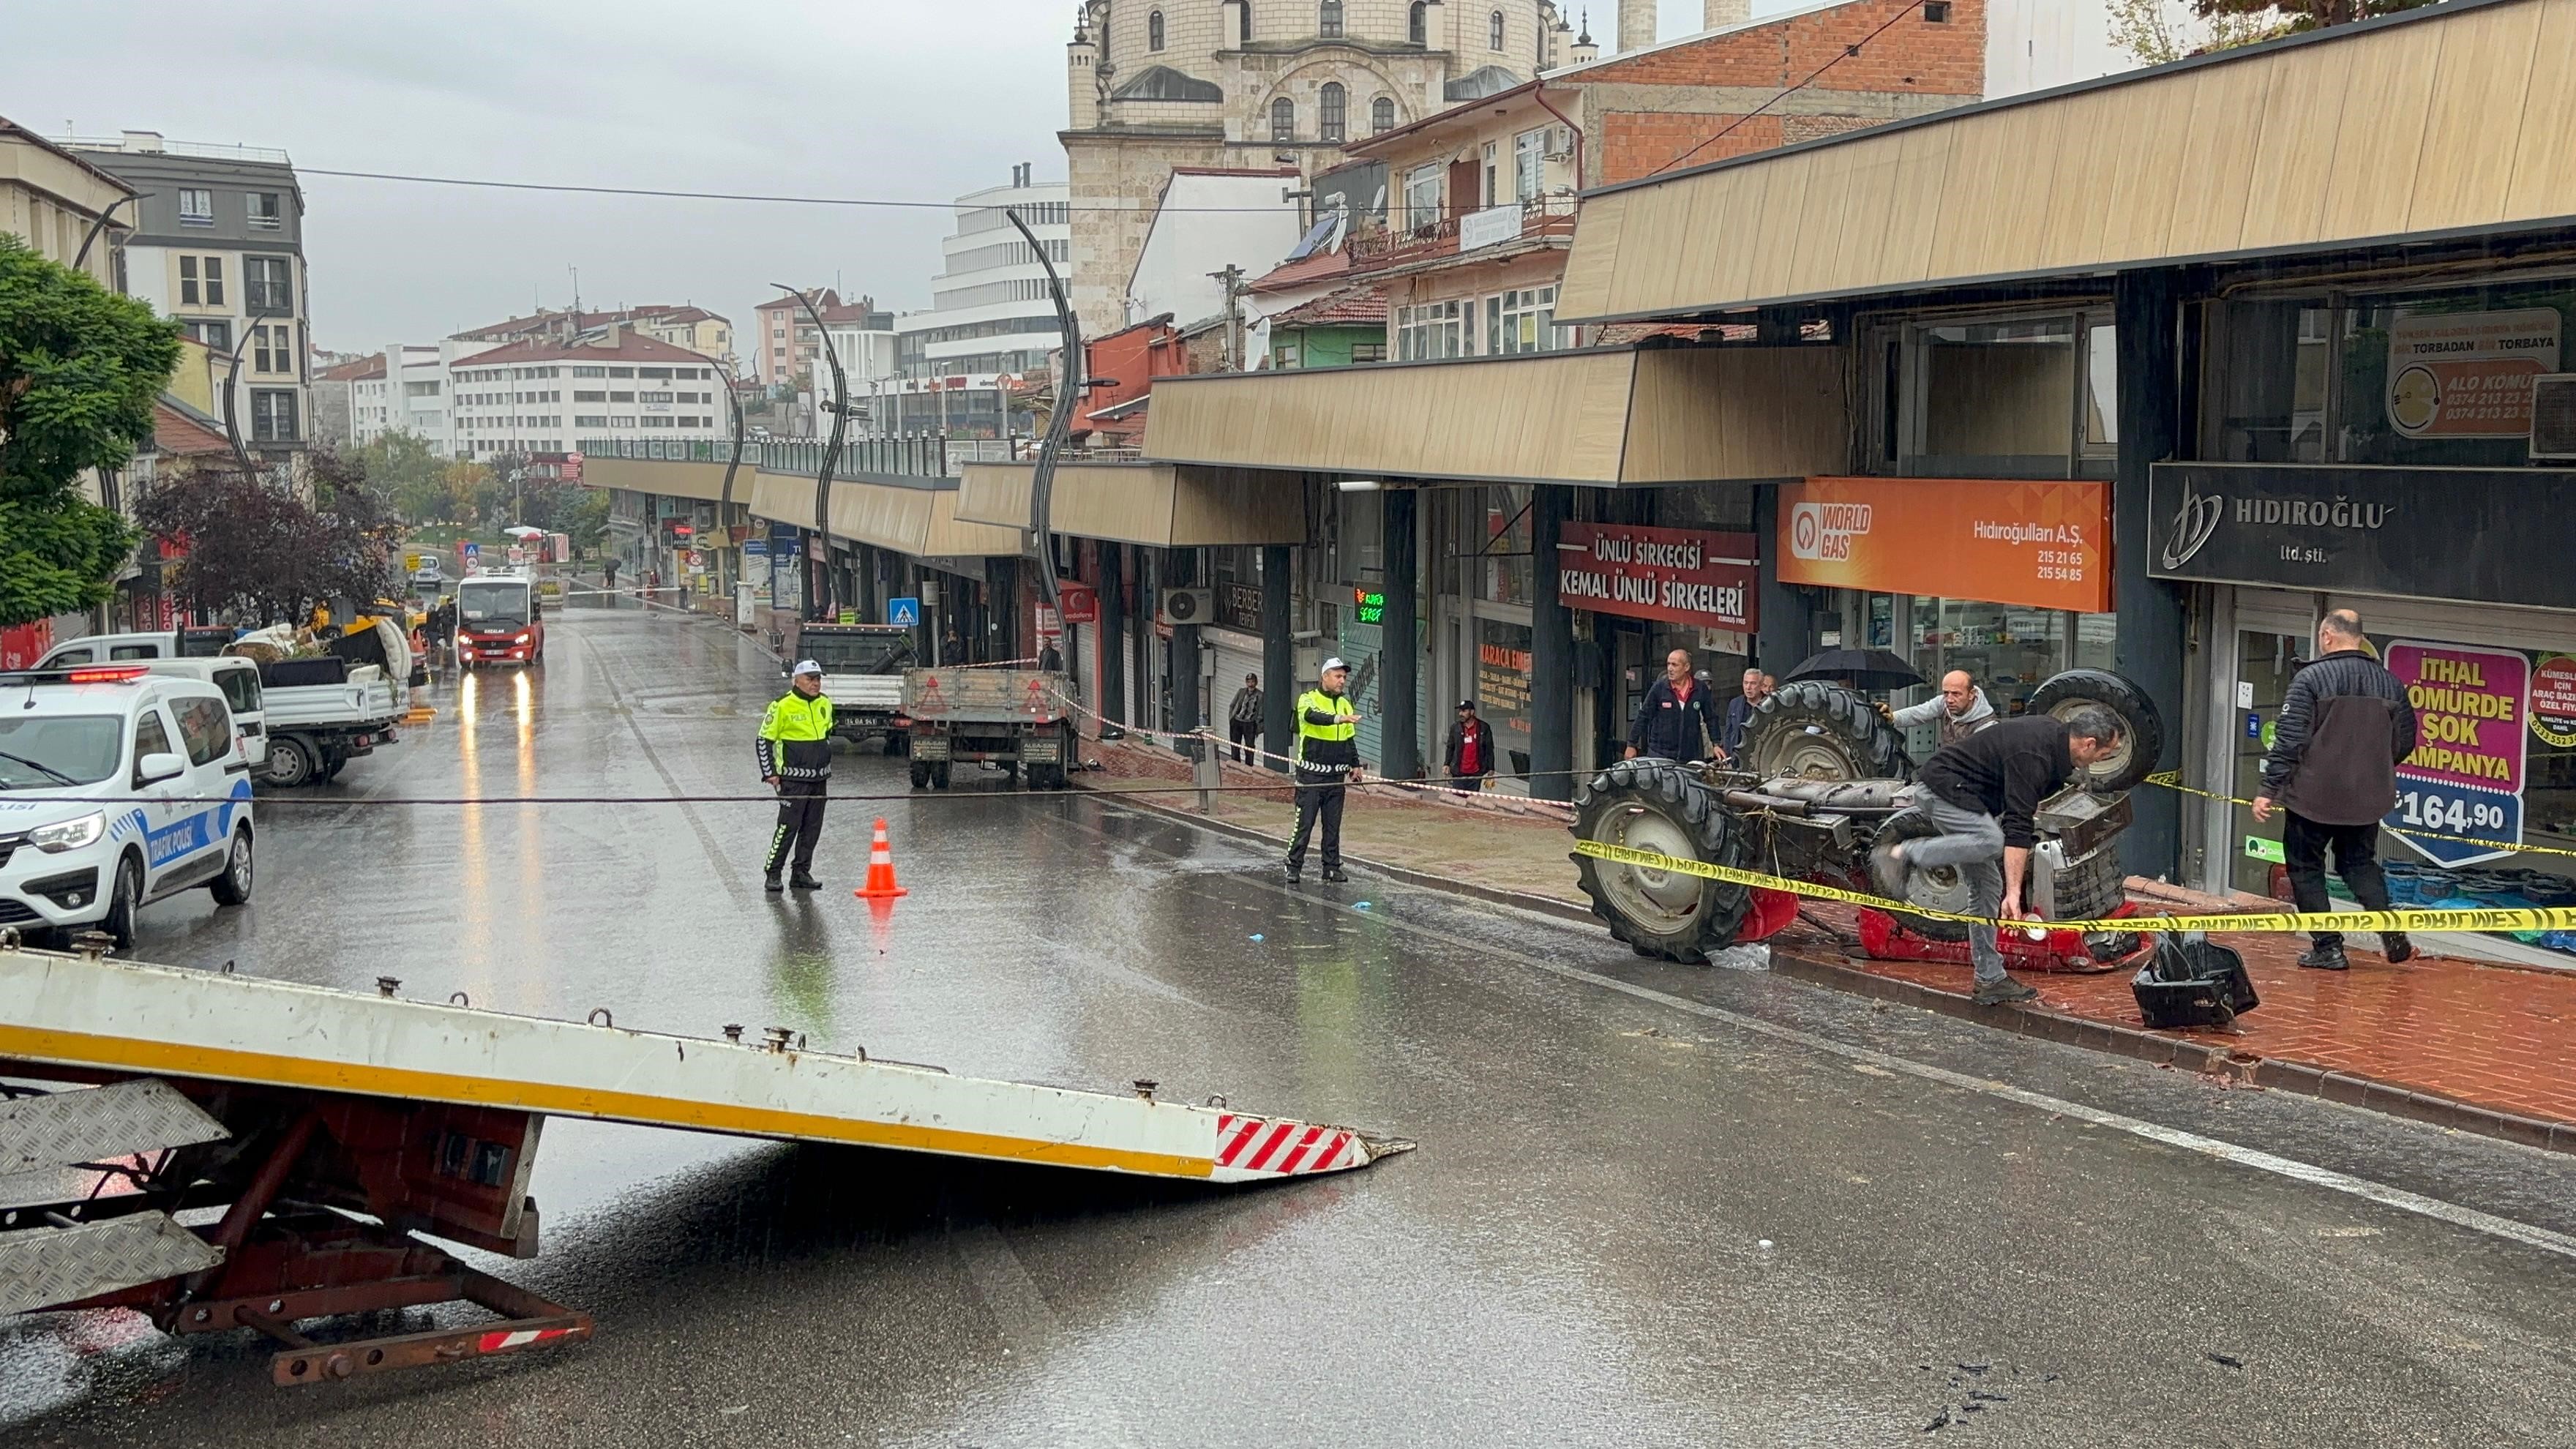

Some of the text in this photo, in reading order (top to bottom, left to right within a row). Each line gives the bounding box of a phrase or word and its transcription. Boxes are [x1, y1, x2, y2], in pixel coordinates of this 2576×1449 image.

[2414, 341, 2474, 354] TORBADAN
[2498, 337, 2554, 351] TORBAYA
[2447, 372, 2534, 391] ALO KÖMÜ
[2447, 394, 2476, 405] 0374
[2478, 393, 2501, 405] 213
[2503, 392, 2520, 404] 23
[2446, 408, 2475, 420] 0374
[2478, 408, 2500, 419] 213
[2503, 407, 2520, 419] 23
[1821, 503, 1871, 532] WORLD
[2236, 495, 2384, 528] HIDIROĞLU
[1821, 533, 1850, 559] GAS
[1974, 520, 2083, 547] Hıdıroğulları A.Ş.
[1595, 533, 1701, 570] ÜNLÜ SİRKECİSİ
[2038, 551, 2083, 564] 215 21 65
[2037, 566, 2082, 581] 215 54 85
[1232, 587, 1263, 613] BERBER
[1562, 568, 1743, 616] KEMAL ÜNLÜ SİRKELERİ
[1238, 610, 1257, 629] TEVFİK
[1480, 644, 1510, 667] KARACA
[2420, 651, 2486, 686] İTHAL
[2542, 669, 2576, 680] KÜMESL
[2554, 680, 2571, 691] İÇİN
[2404, 679, 2515, 720] ÖMÜRDE
[2532, 689, 2555, 700] ARAÇ
[2539, 699, 2561, 710] ÖZEL
[2422, 713, 2479, 746] ŞOK
[2532, 719, 2549, 739] 0533
[2551, 735, 2566, 745] 552
[2401, 746, 2511, 781] AMPANYA
[151, 820, 193, 863] TRAFİK POLİSİ
